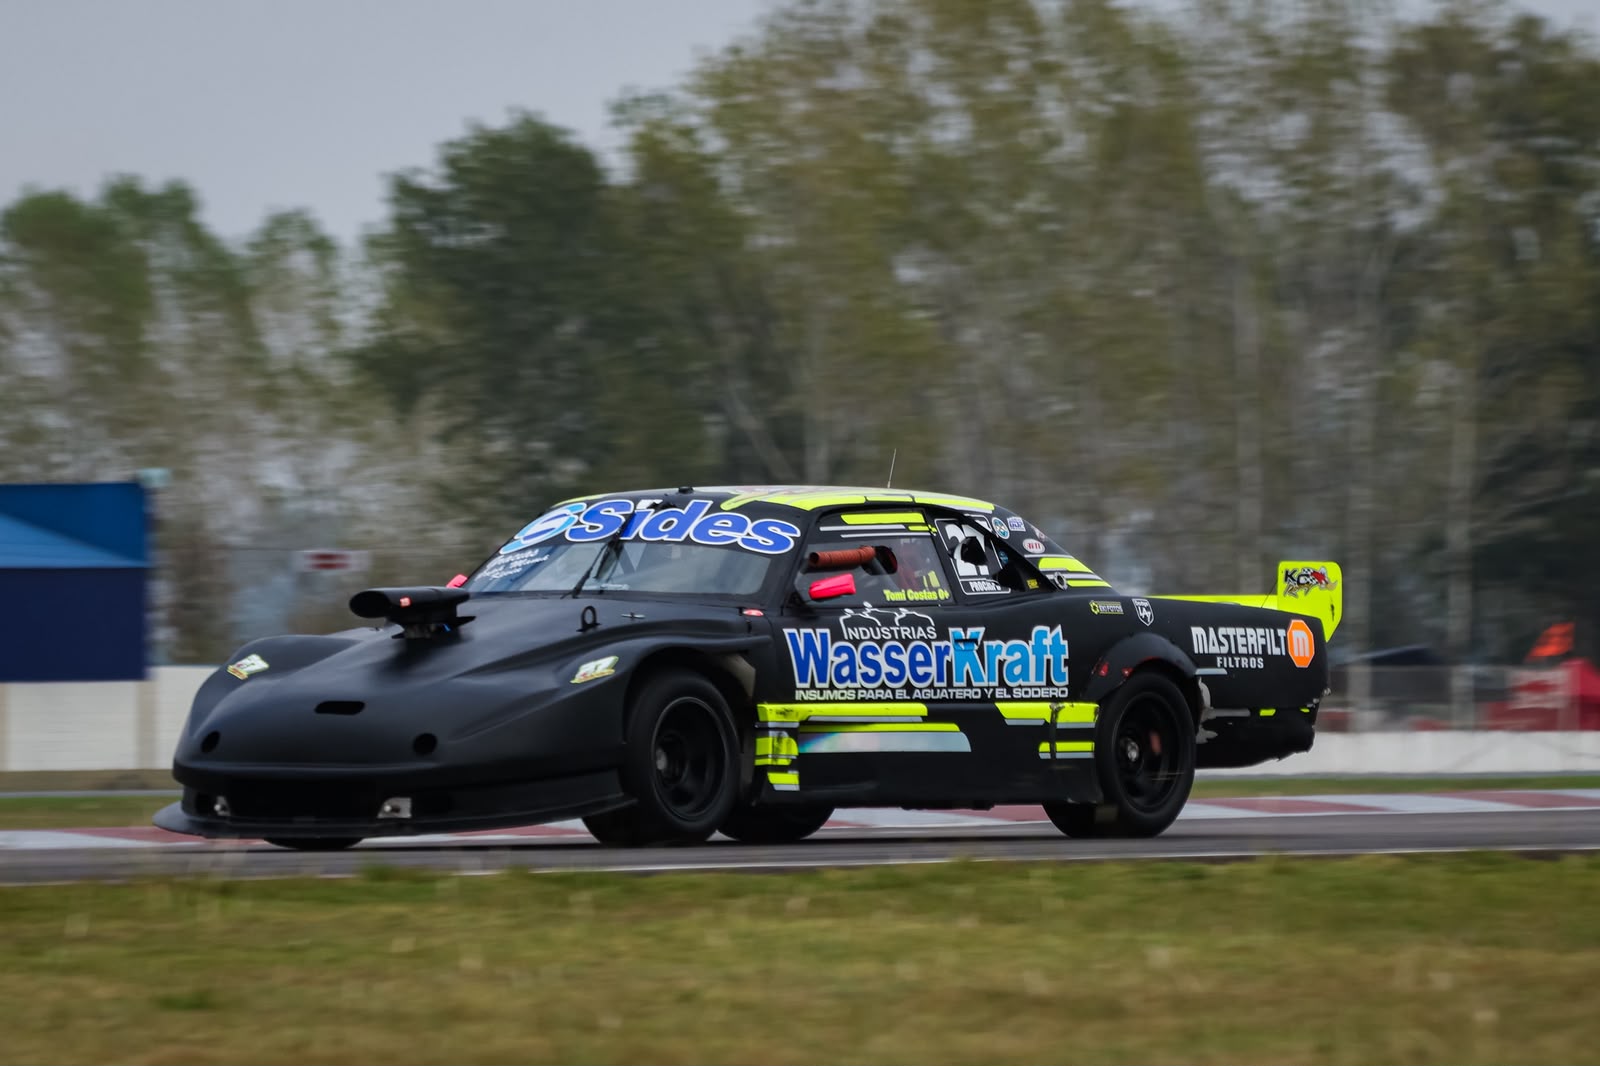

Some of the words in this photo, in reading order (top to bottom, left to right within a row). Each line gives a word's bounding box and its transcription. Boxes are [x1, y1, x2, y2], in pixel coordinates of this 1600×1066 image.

[883, 589, 906, 601] Tomi
[907, 588, 937, 601] Costas
[843, 625, 938, 641] INDUSTRIAS
[1190, 626, 1287, 656] MASTERFILT
[783, 624, 1070, 688] WasserKraft
[1216, 656, 1265, 669] FILTROS
[795, 690, 856, 700] INSUMOS
[857, 690, 893, 700] PARA
[895, 689, 912, 700] EL
[913, 688, 982, 699] AGUATERO
[983, 688, 993, 699] Y
[995, 688, 1013, 699] EL
[1014, 687, 1070, 699] SODERO
